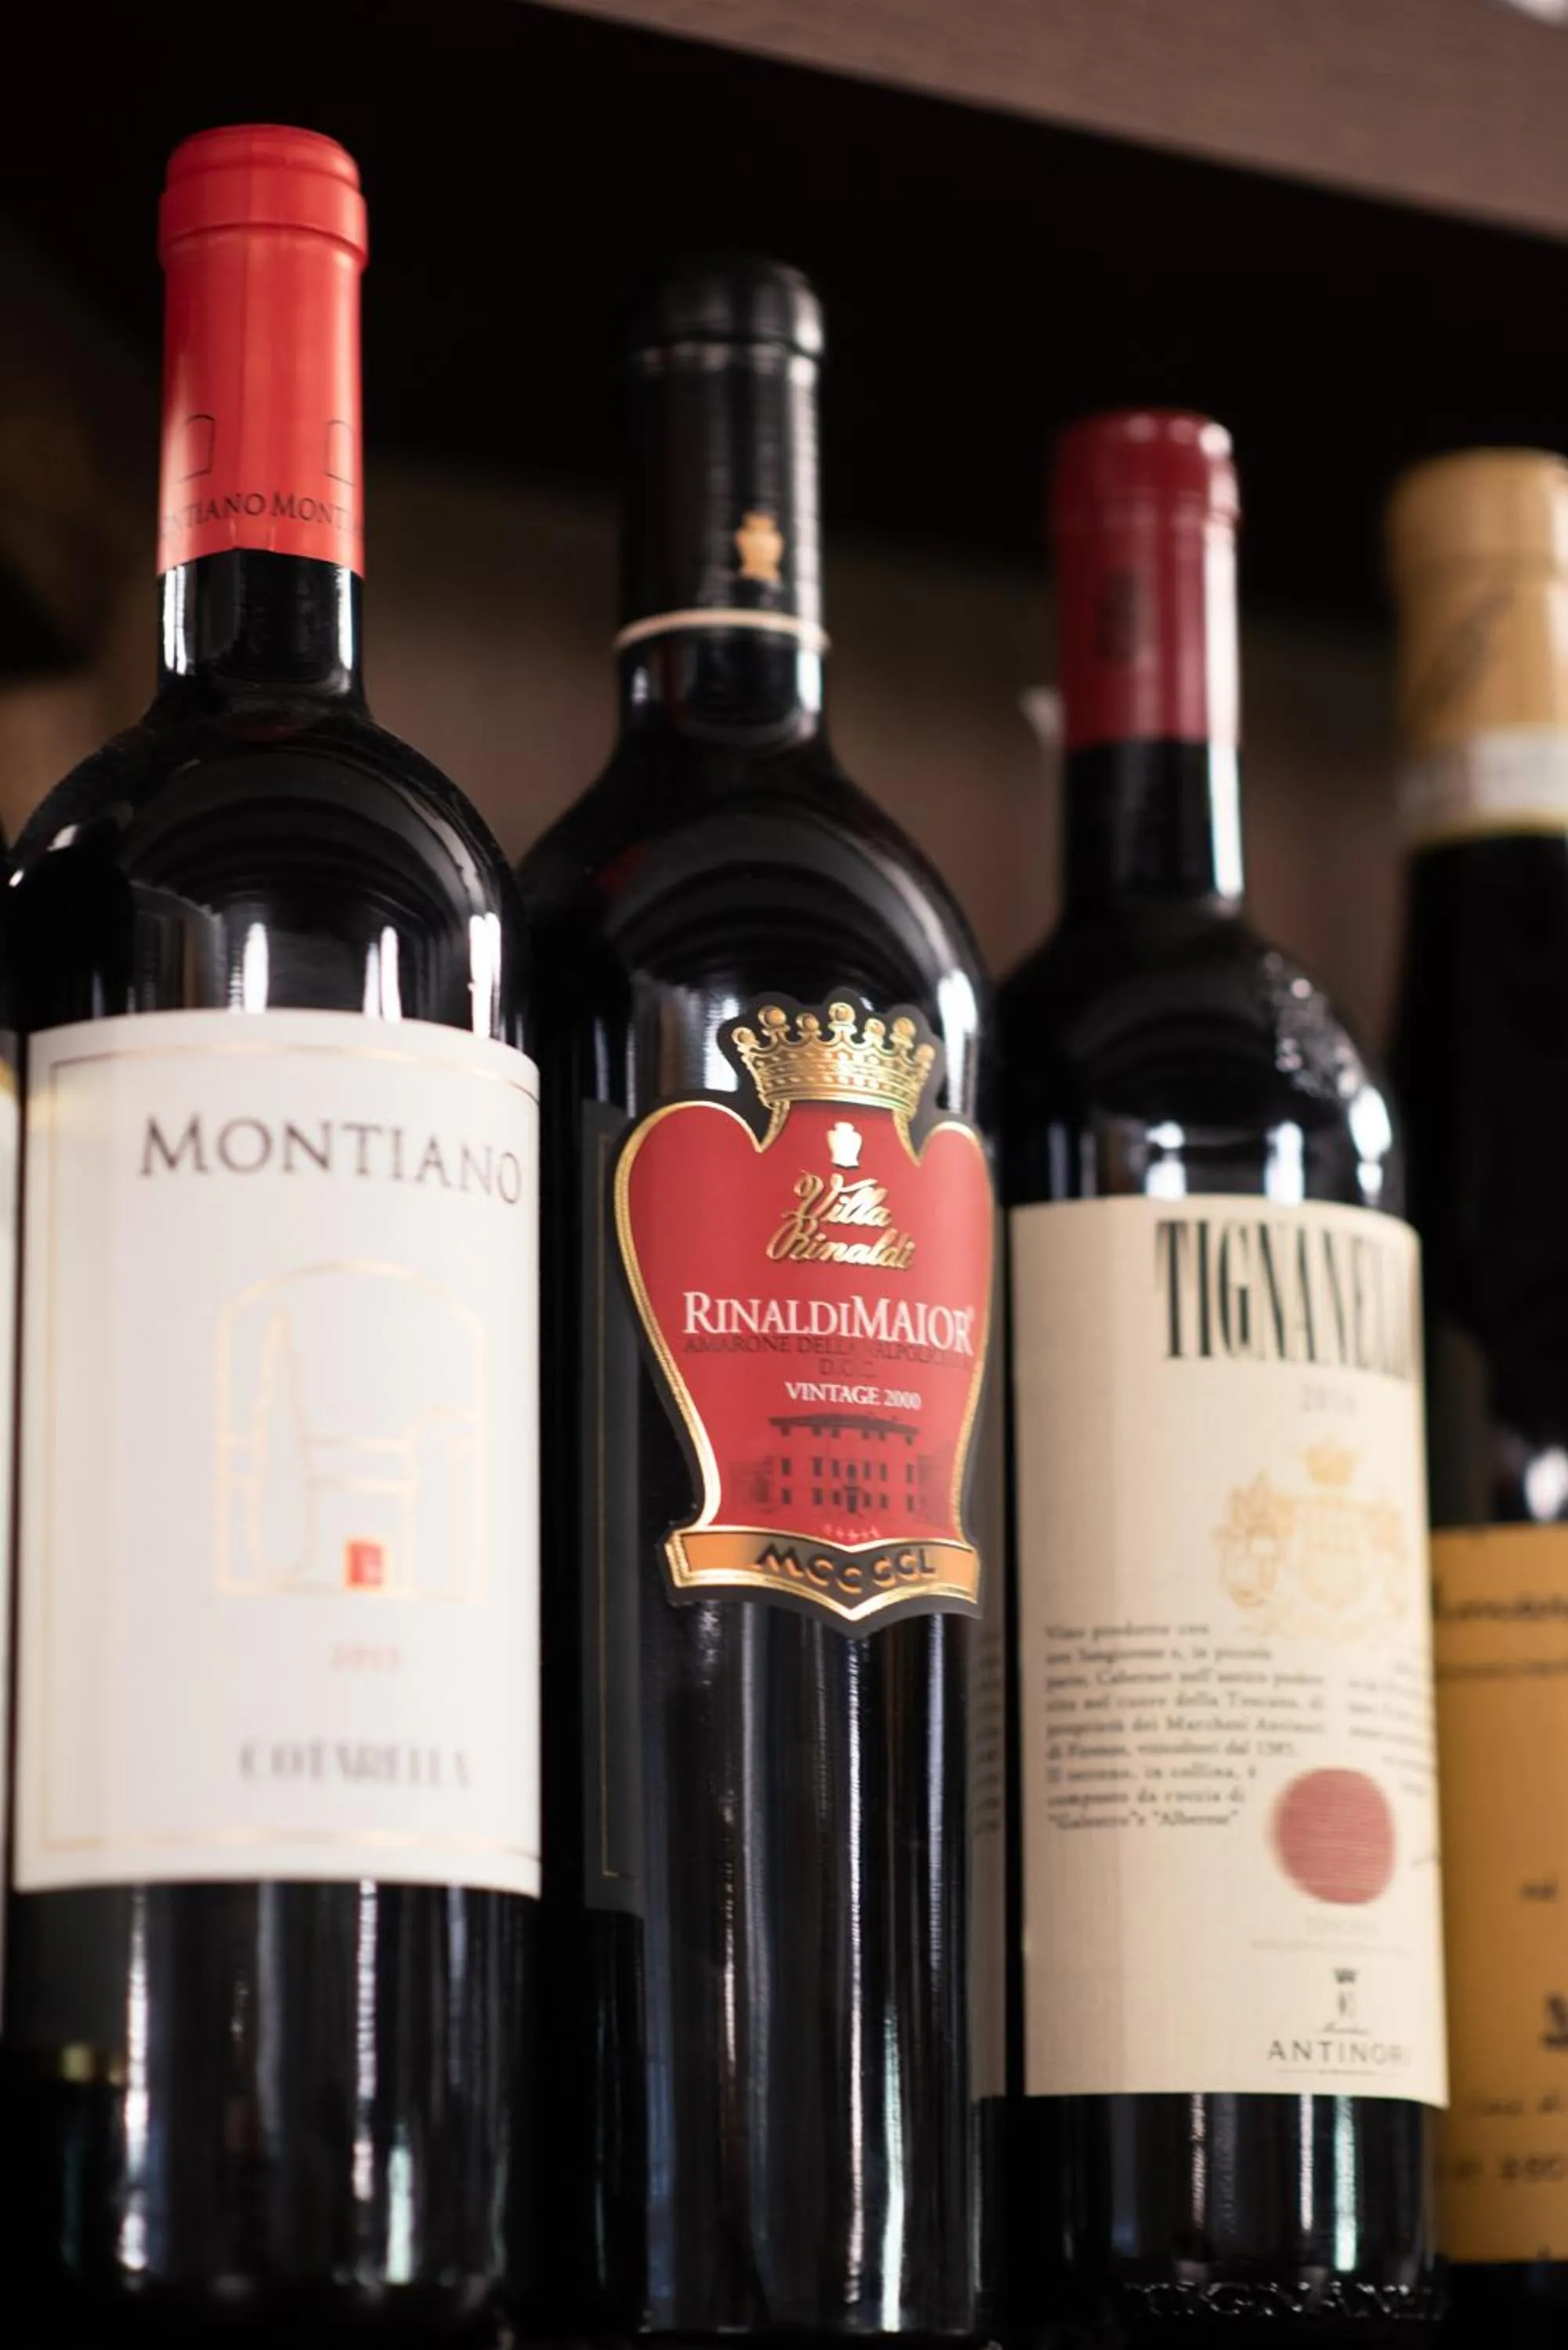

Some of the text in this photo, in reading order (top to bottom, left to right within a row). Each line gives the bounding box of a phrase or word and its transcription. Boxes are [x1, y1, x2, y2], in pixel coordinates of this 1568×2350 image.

[140, 1112, 522, 1205] MONTIANO
[793, 1170, 891, 1227] Villa
[765, 1211, 916, 1270] Rinaldi
[784, 1382, 922, 1411] VINTAGE 2000
[1266, 2038, 1411, 2066] ANTINOR
